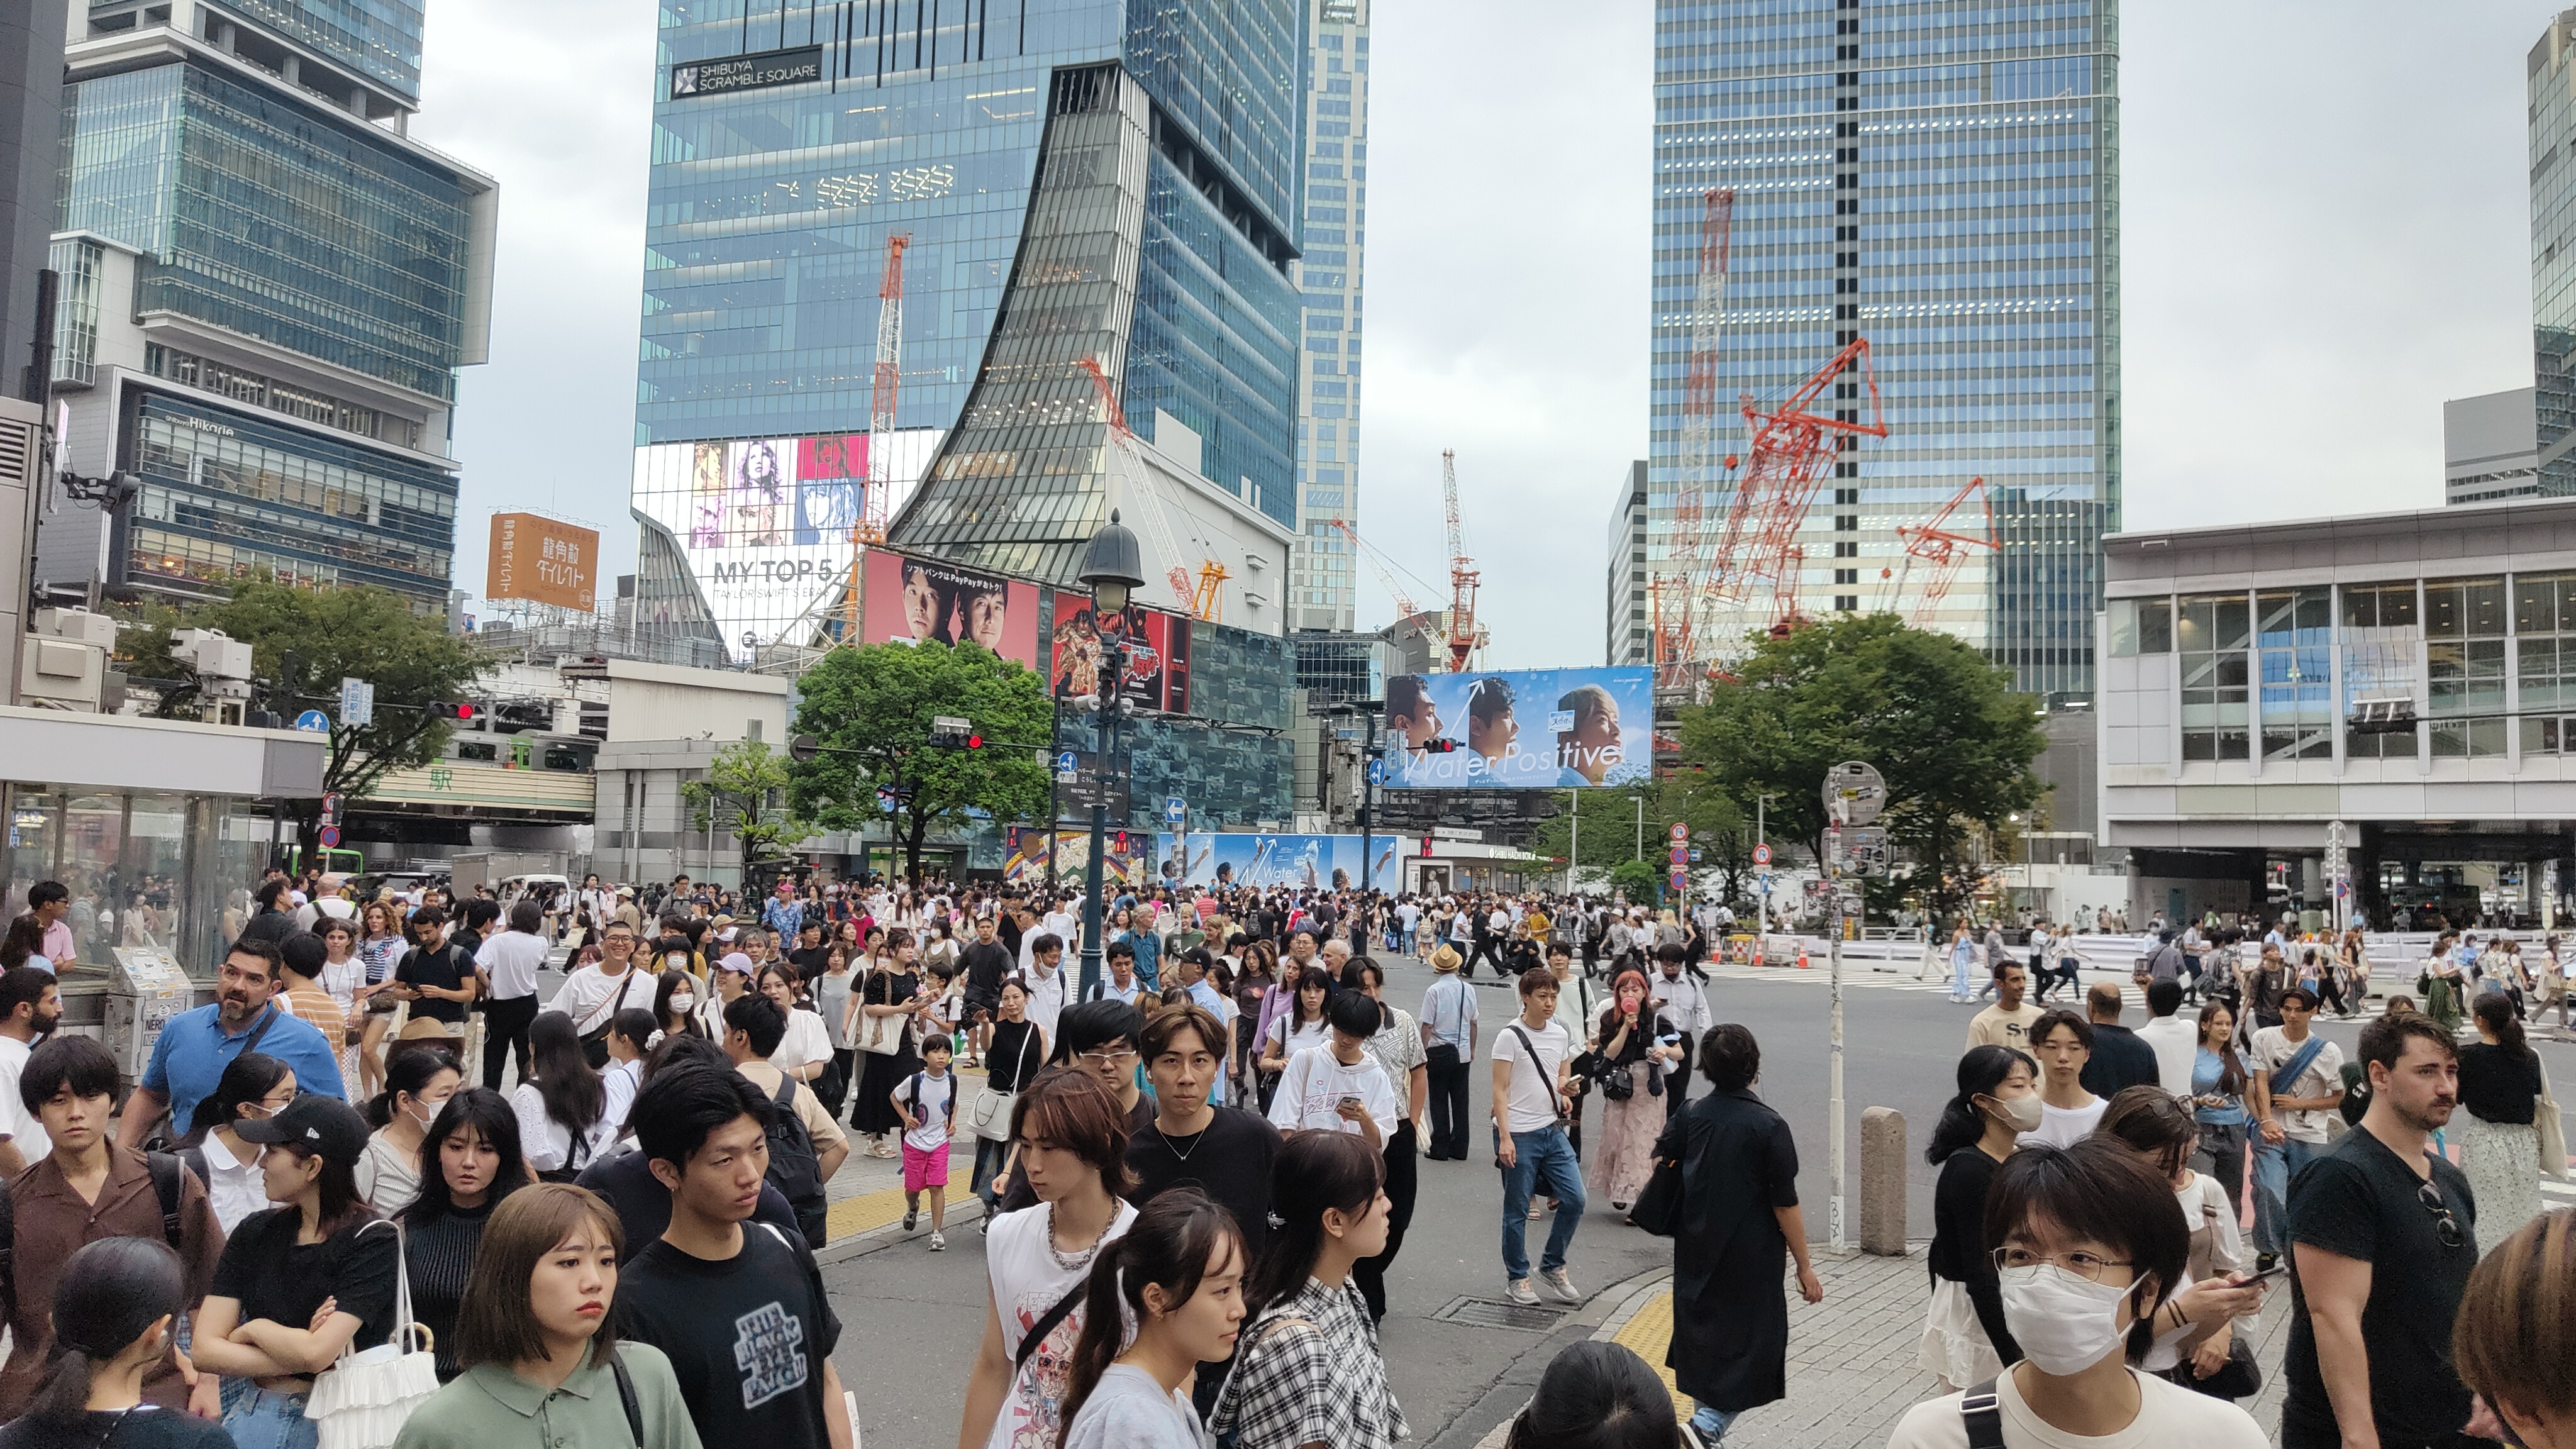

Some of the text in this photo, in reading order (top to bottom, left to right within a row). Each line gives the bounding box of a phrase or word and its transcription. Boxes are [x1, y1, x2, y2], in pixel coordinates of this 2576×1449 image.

[700, 65, 817, 91] SCRAMBLE SQUARE
[701, 60, 753, 78] SHIBUYA
[189, 417, 234, 437] Hikarie
[543, 536, 579, 565] 龍角散
[536, 560, 584, 588] ダイレクト
[714, 559, 832, 584] MY TOP 5
[714, 589, 753, 599] TAYLOR
[757, 587, 799, 598] SWIFT'S
[349, 682, 360, 721] 渋谷駅前
[1404, 738, 1621, 783] Water Positive
[430, 769, 452, 791] 駅
[1494, 850, 1507, 859] SHIBU
[1507, 850, 1522, 860] HACHI
[1523, 851, 1532, 860] BOX
[1263, 865, 1298, 879] Water
